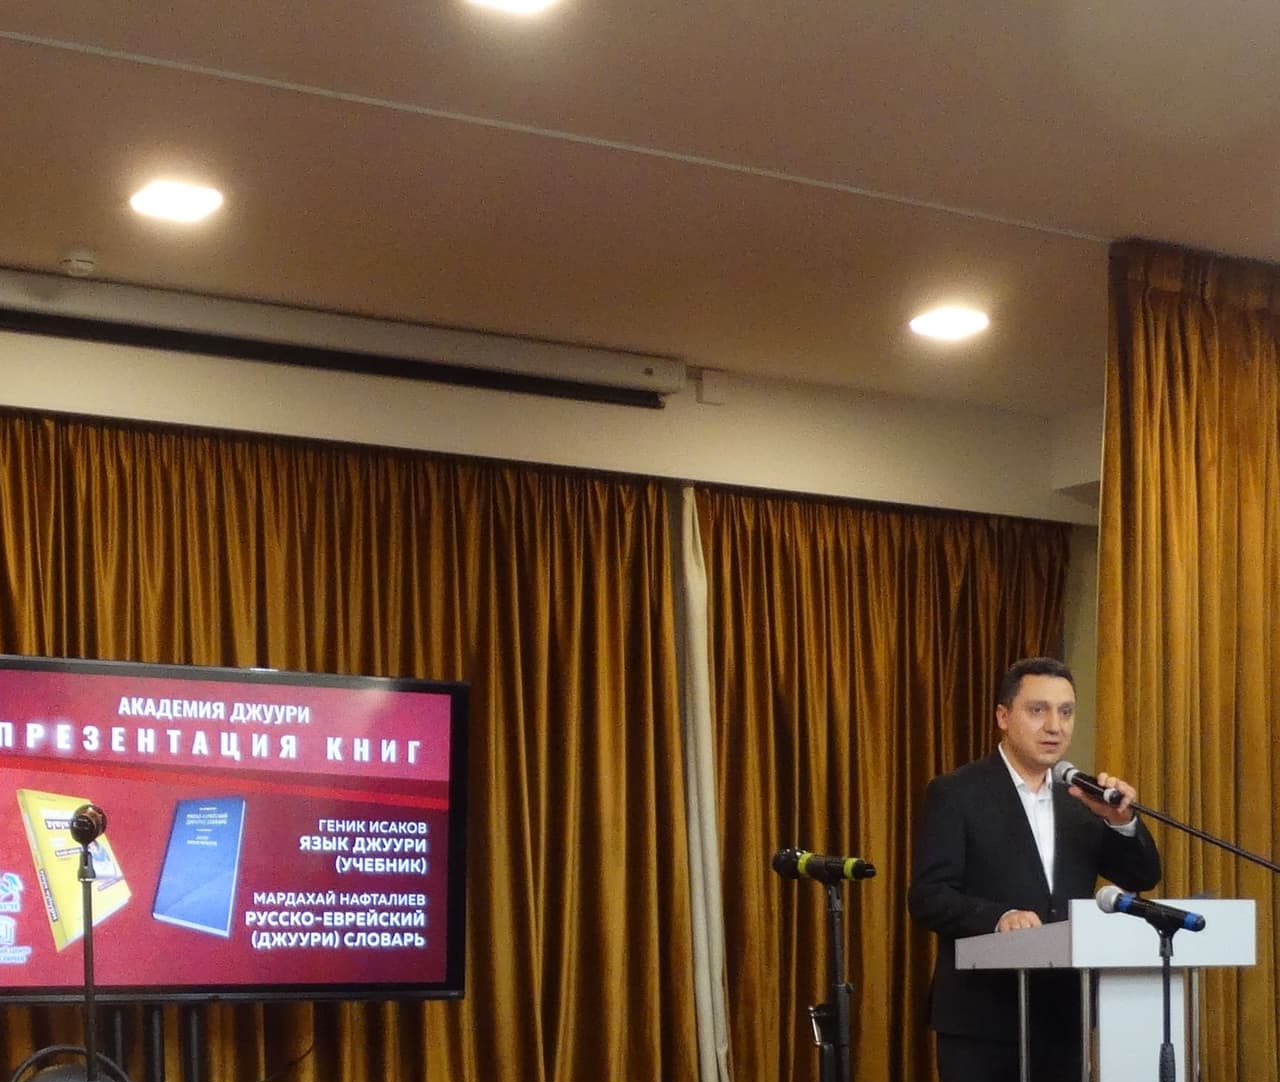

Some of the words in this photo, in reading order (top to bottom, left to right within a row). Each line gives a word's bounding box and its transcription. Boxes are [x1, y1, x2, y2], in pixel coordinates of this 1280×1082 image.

[118, 696, 224, 721] АКАДЕМИЯ
[230, 702, 310, 725] ДЖУУРИ
[326, 738, 421, 764] КНИГ
[318, 819, 365, 834] ГЕНИК
[370, 820, 427, 834] ИСАКОВ
[299, 836, 348, 852] ЯЗЫК
[352, 837, 427, 855] ДЖУУРИ
[335, 856, 427, 875] (УЧЕБНИК)
[253, 890, 336, 908] МАРДАХАЙ
[340, 893, 426, 907] НАФТАЛИЕВ
[245, 908, 425, 927] РУССКО-ЕВРЕЙСКИЙ
[251, 931, 340, 949] (ДЖУУРИ)
[343, 932, 425, 947] СЛОВАРЬ
